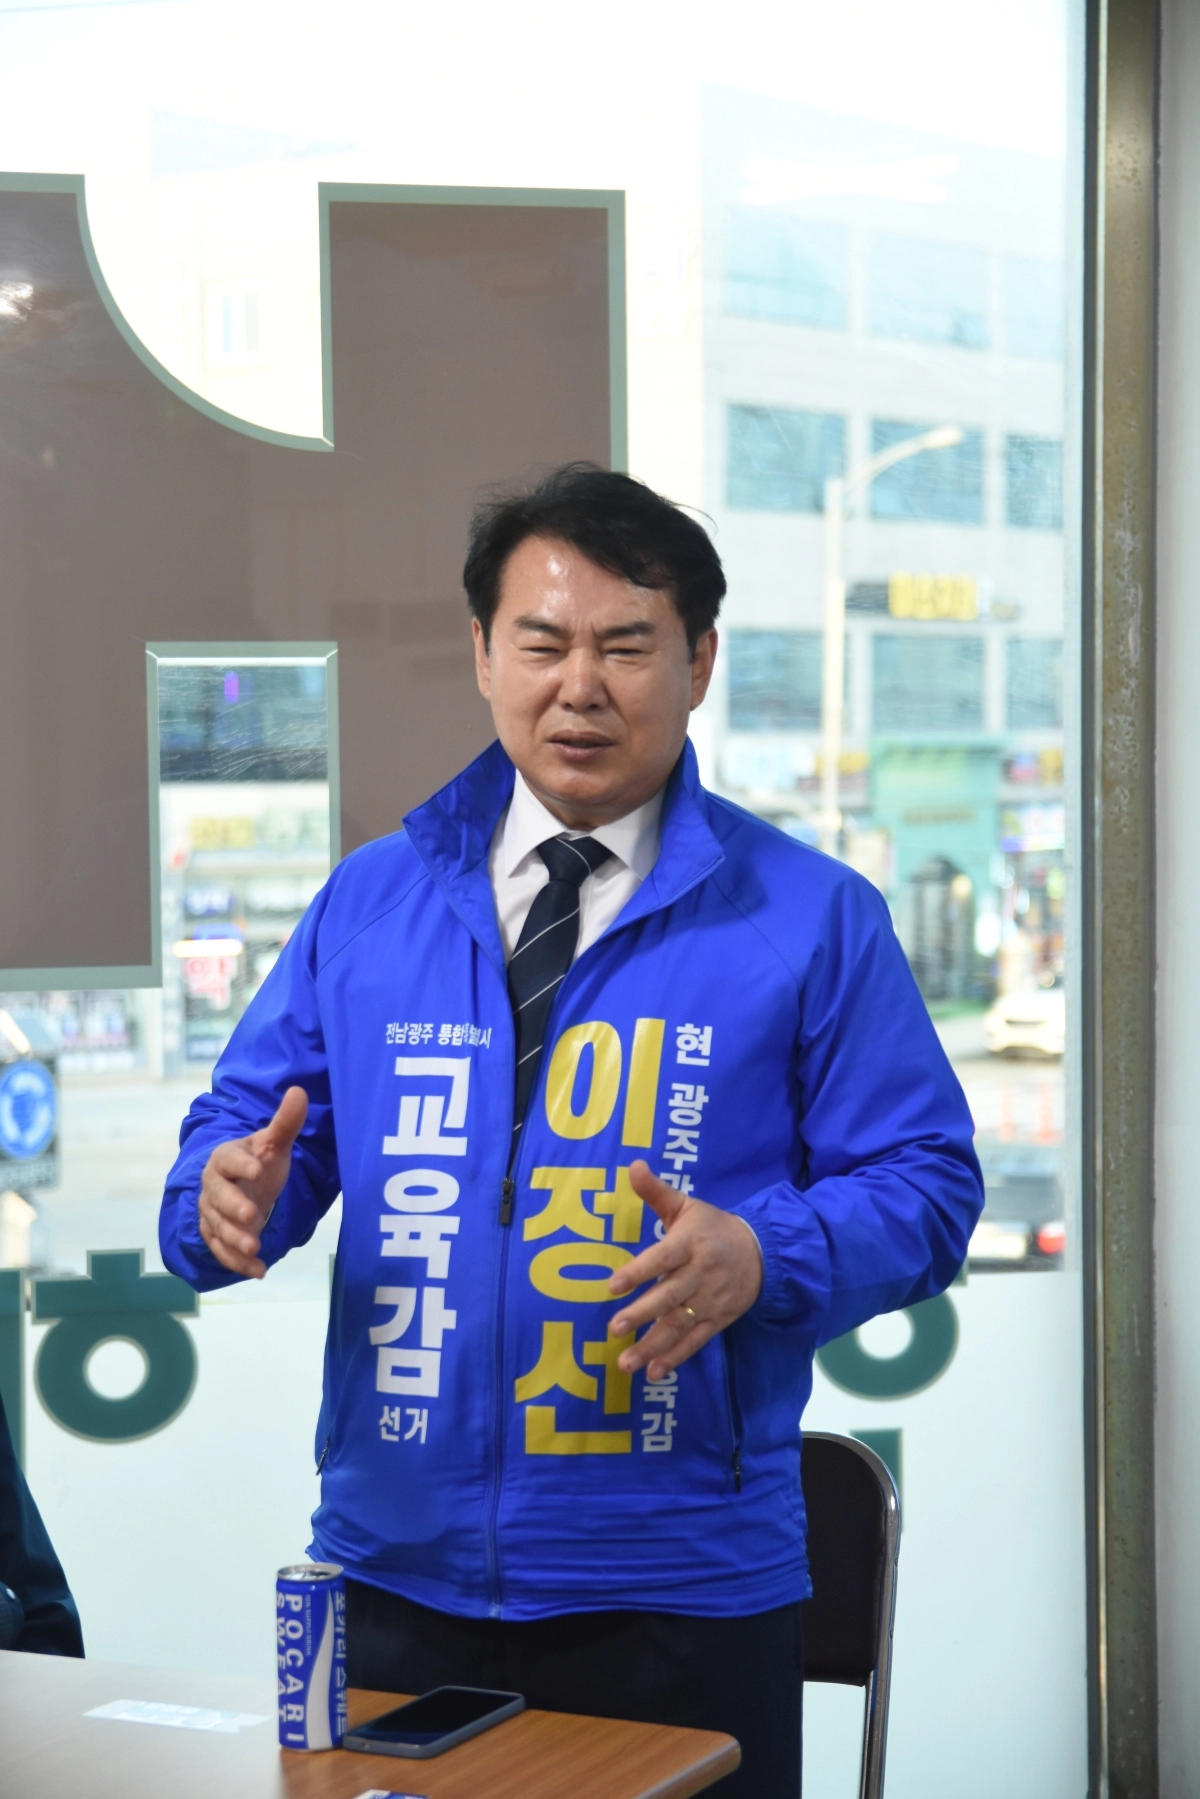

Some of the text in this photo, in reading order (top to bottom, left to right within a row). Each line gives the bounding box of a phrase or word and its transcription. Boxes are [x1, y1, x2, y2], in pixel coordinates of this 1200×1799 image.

[386, 1022, 434, 1045] 전남광주
[675, 1023, 713, 1067] 현
[369, 1056, 471, 1398] 교육감
[515, 1018, 666, 1455] 이정선
[379, 1405, 429, 1445] 선거
[285, 1593, 304, 1742] POCARI
